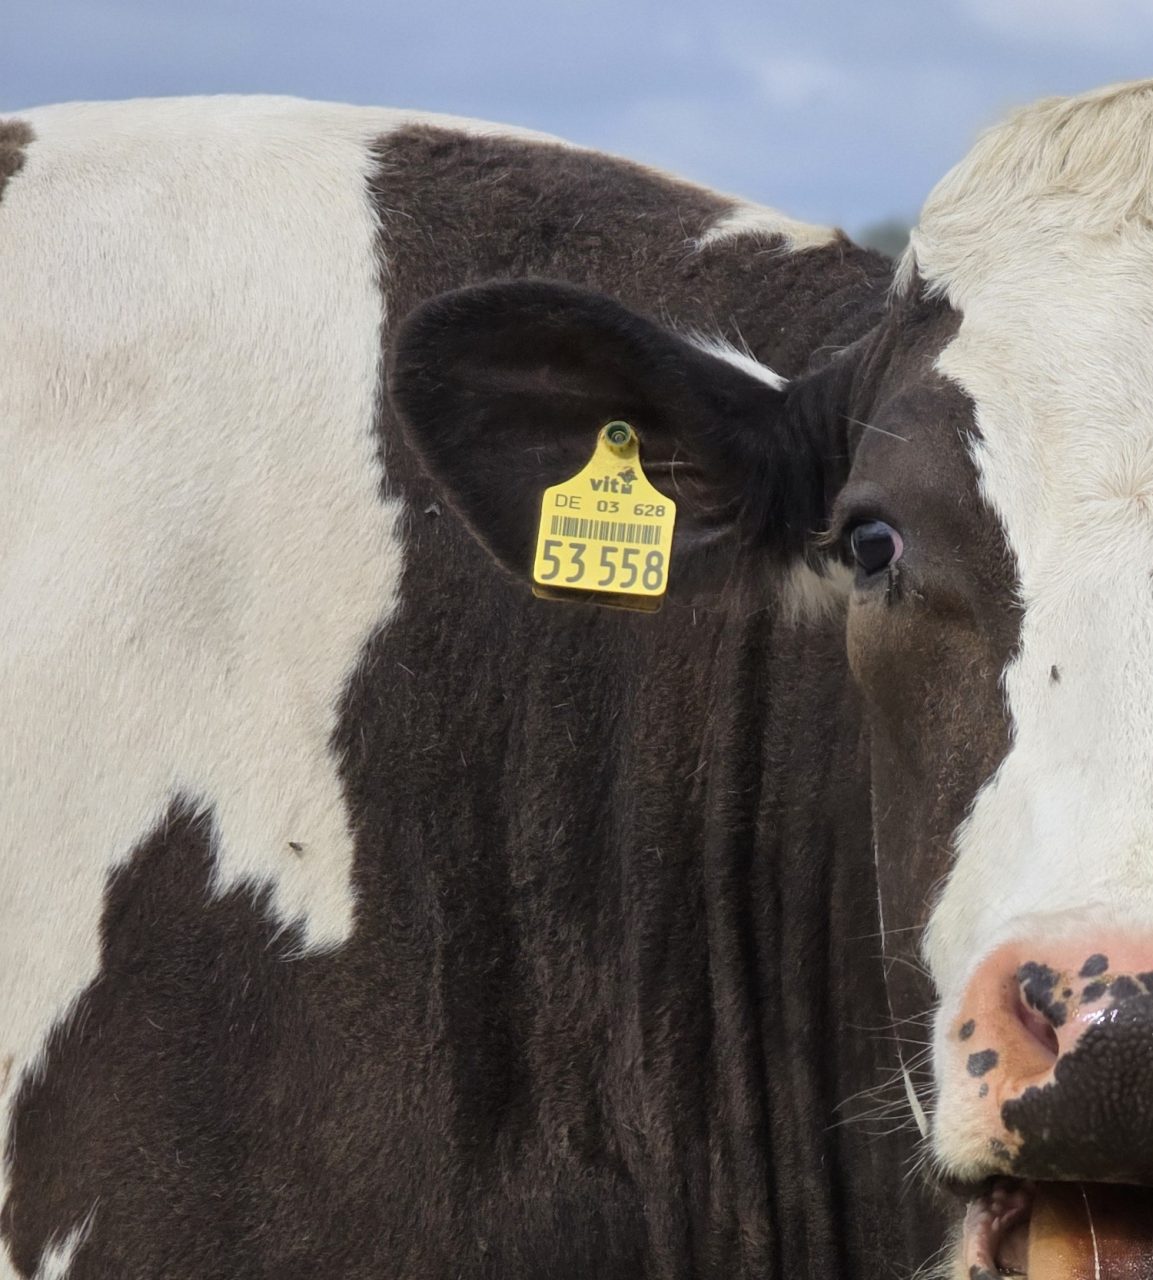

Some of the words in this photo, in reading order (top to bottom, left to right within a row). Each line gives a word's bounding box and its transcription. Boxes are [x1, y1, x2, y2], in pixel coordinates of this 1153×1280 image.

[554, 494, 582, 510] DE
[596, 500, 620, 513] 03
[633, 503, 666, 517] 628
[541, 540, 587, 583] 53
[598, 546, 664, 590] 558
